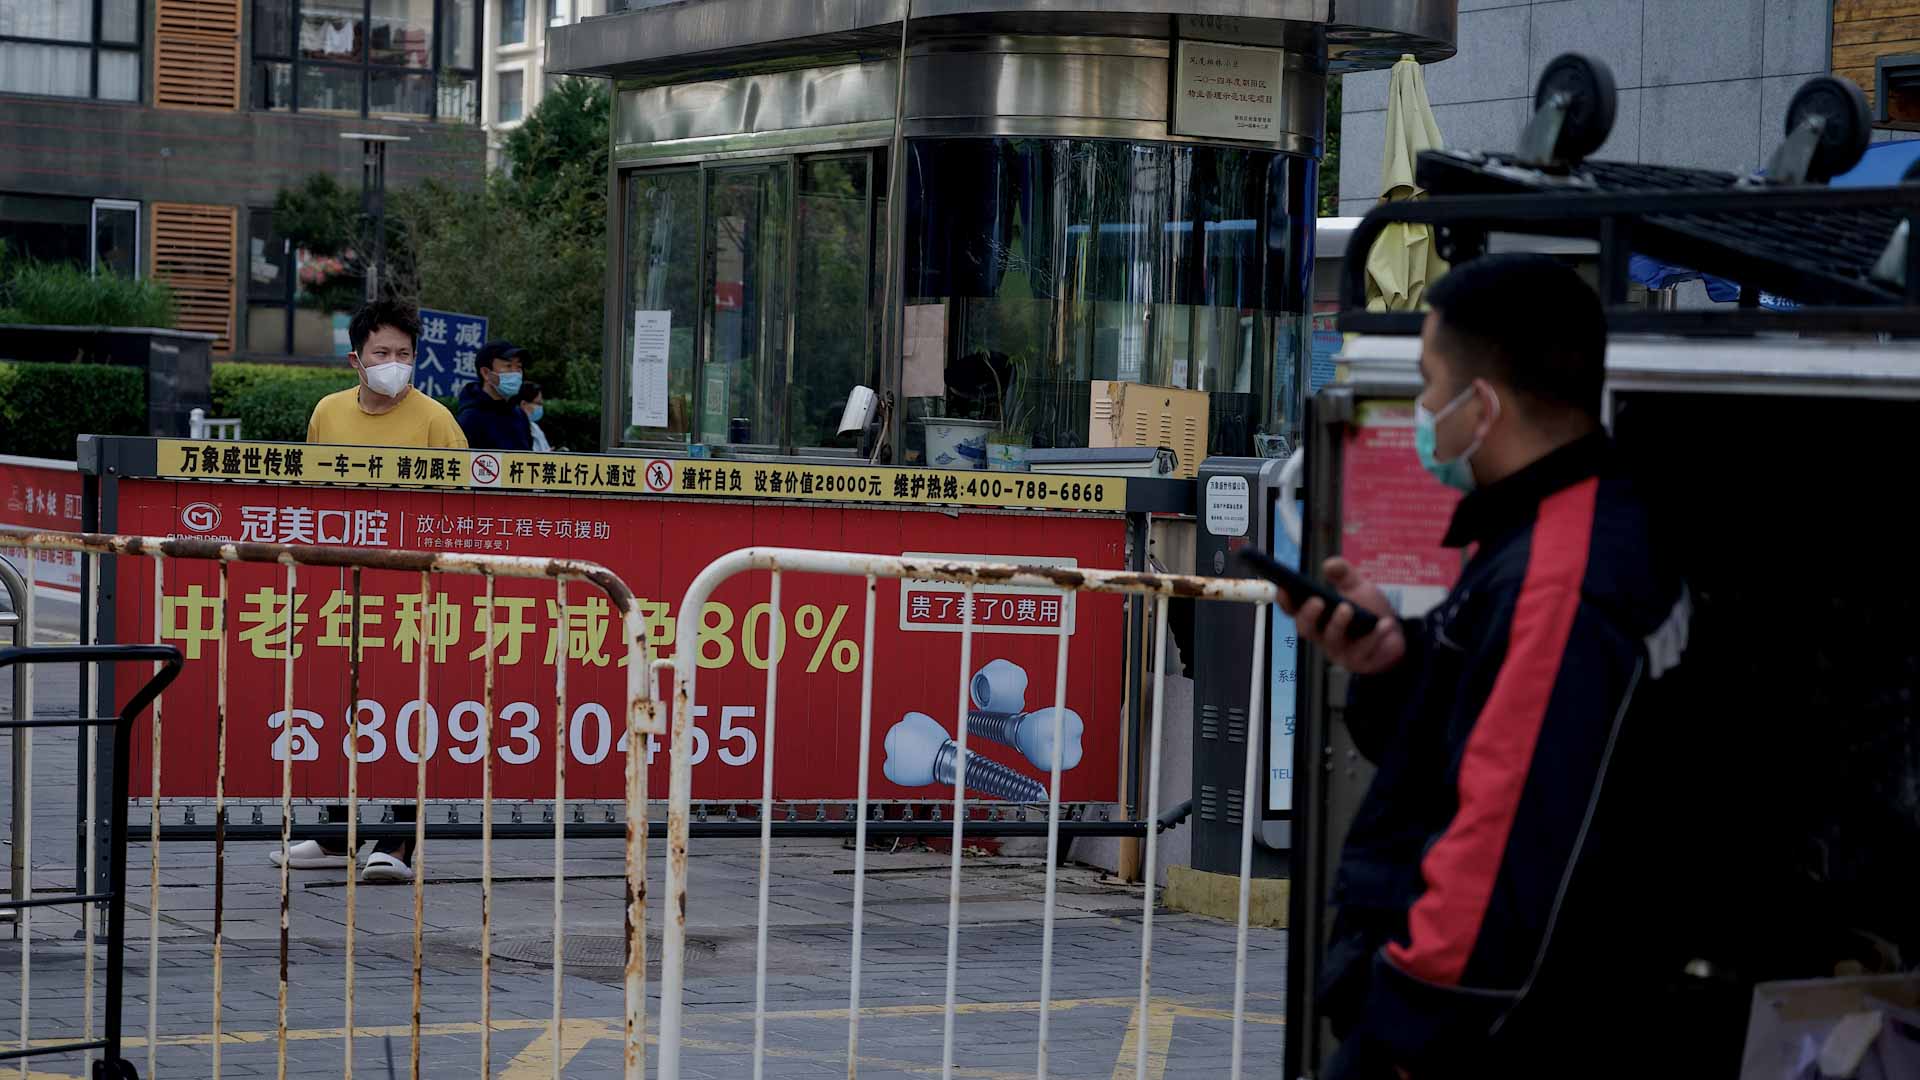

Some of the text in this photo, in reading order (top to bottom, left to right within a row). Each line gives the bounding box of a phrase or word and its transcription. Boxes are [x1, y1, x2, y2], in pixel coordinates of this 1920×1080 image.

[180, 445, 461, 482] 万象盛世传媒 一车一杆 请勿跟车
[509, 460, 1104, 503] 杆下禁止行人通过 撞杆自负 设备价值28000元 维护热线:400-788-6868
[239, 506, 388, 547] 冠美口腔
[416, 513, 612, 541] 放心种牙工程专项援助
[911, 595, 1060, 622] 贵了差了0费用
[342, 699, 541, 765] 8093
